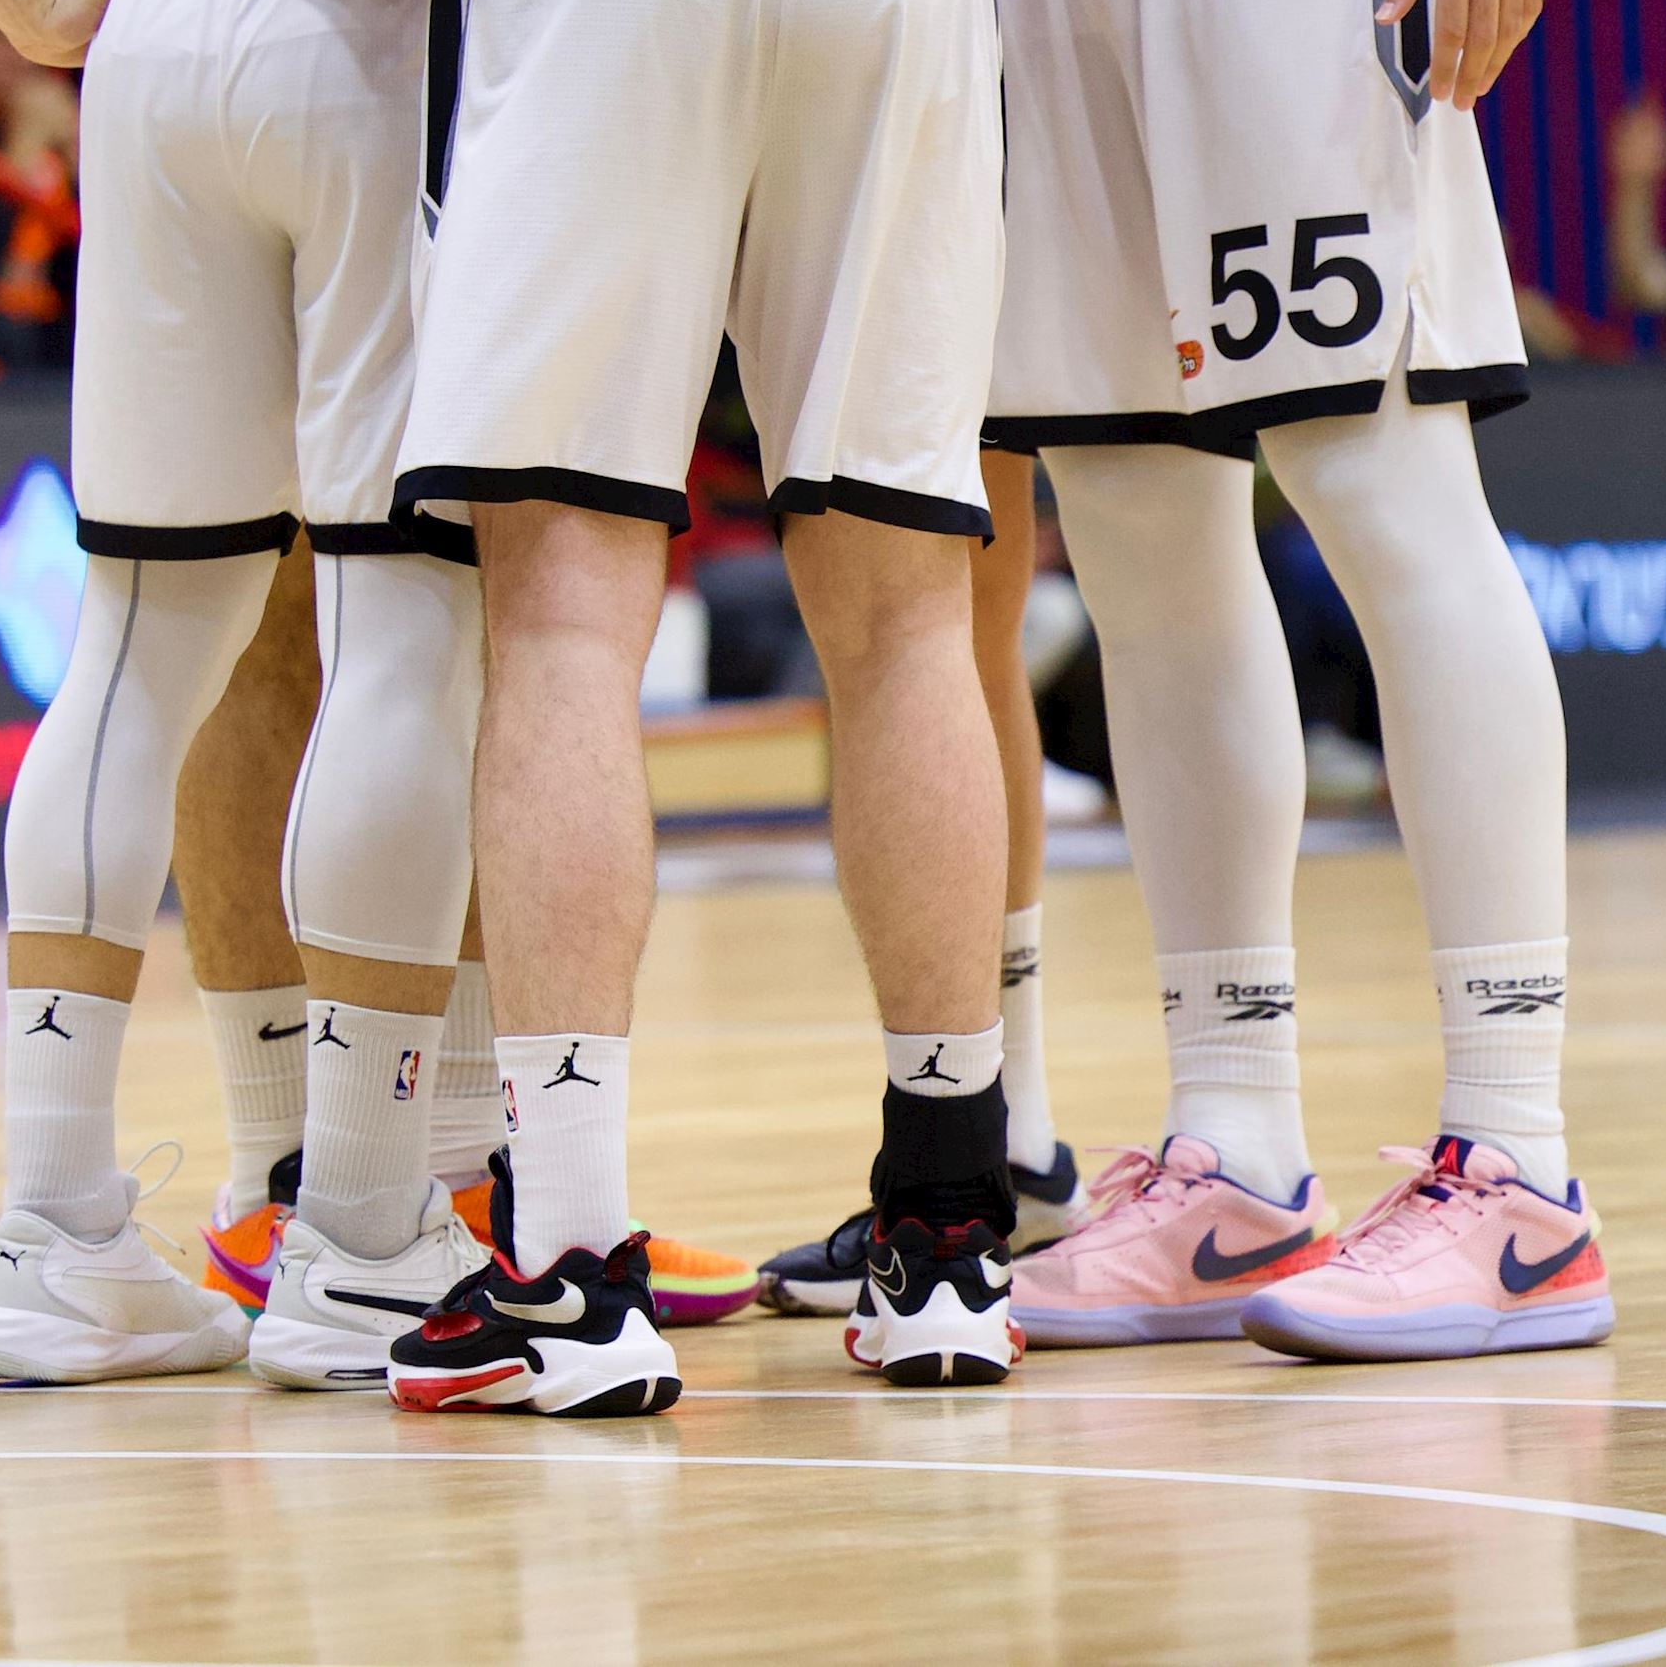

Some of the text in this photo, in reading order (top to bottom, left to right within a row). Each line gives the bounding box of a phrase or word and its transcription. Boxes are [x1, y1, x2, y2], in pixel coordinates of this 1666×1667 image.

[1210, 213, 1384, 361] 55
[1216, 983, 1295, 1001] Reeb
[1466, 974, 1565, 996] Reeb
